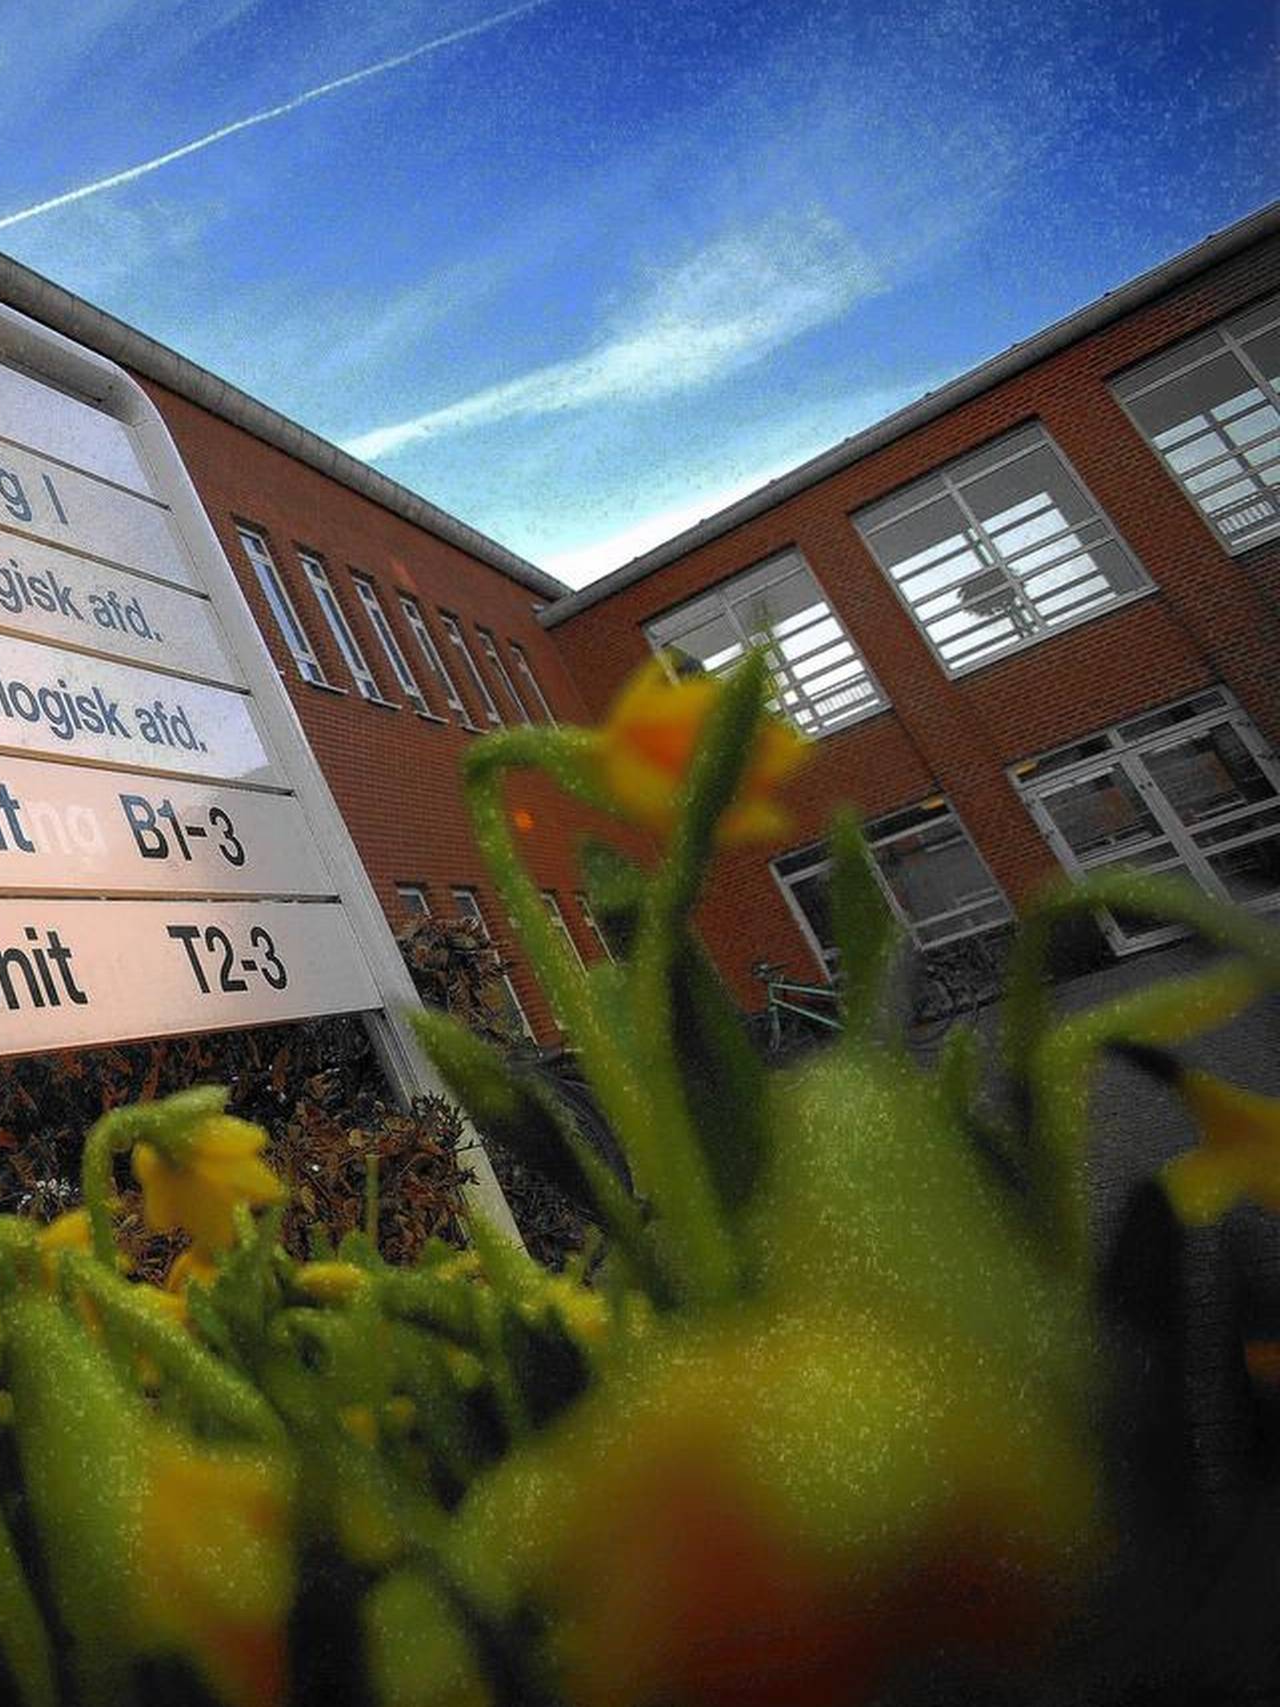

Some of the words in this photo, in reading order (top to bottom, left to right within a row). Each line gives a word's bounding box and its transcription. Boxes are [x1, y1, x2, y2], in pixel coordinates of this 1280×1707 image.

[89, 592, 163, 642] afd.
[134, 706, 208, 753] afd.
[120, 793, 245, 866] B1-3
[167, 926, 288, 991] T2-3
